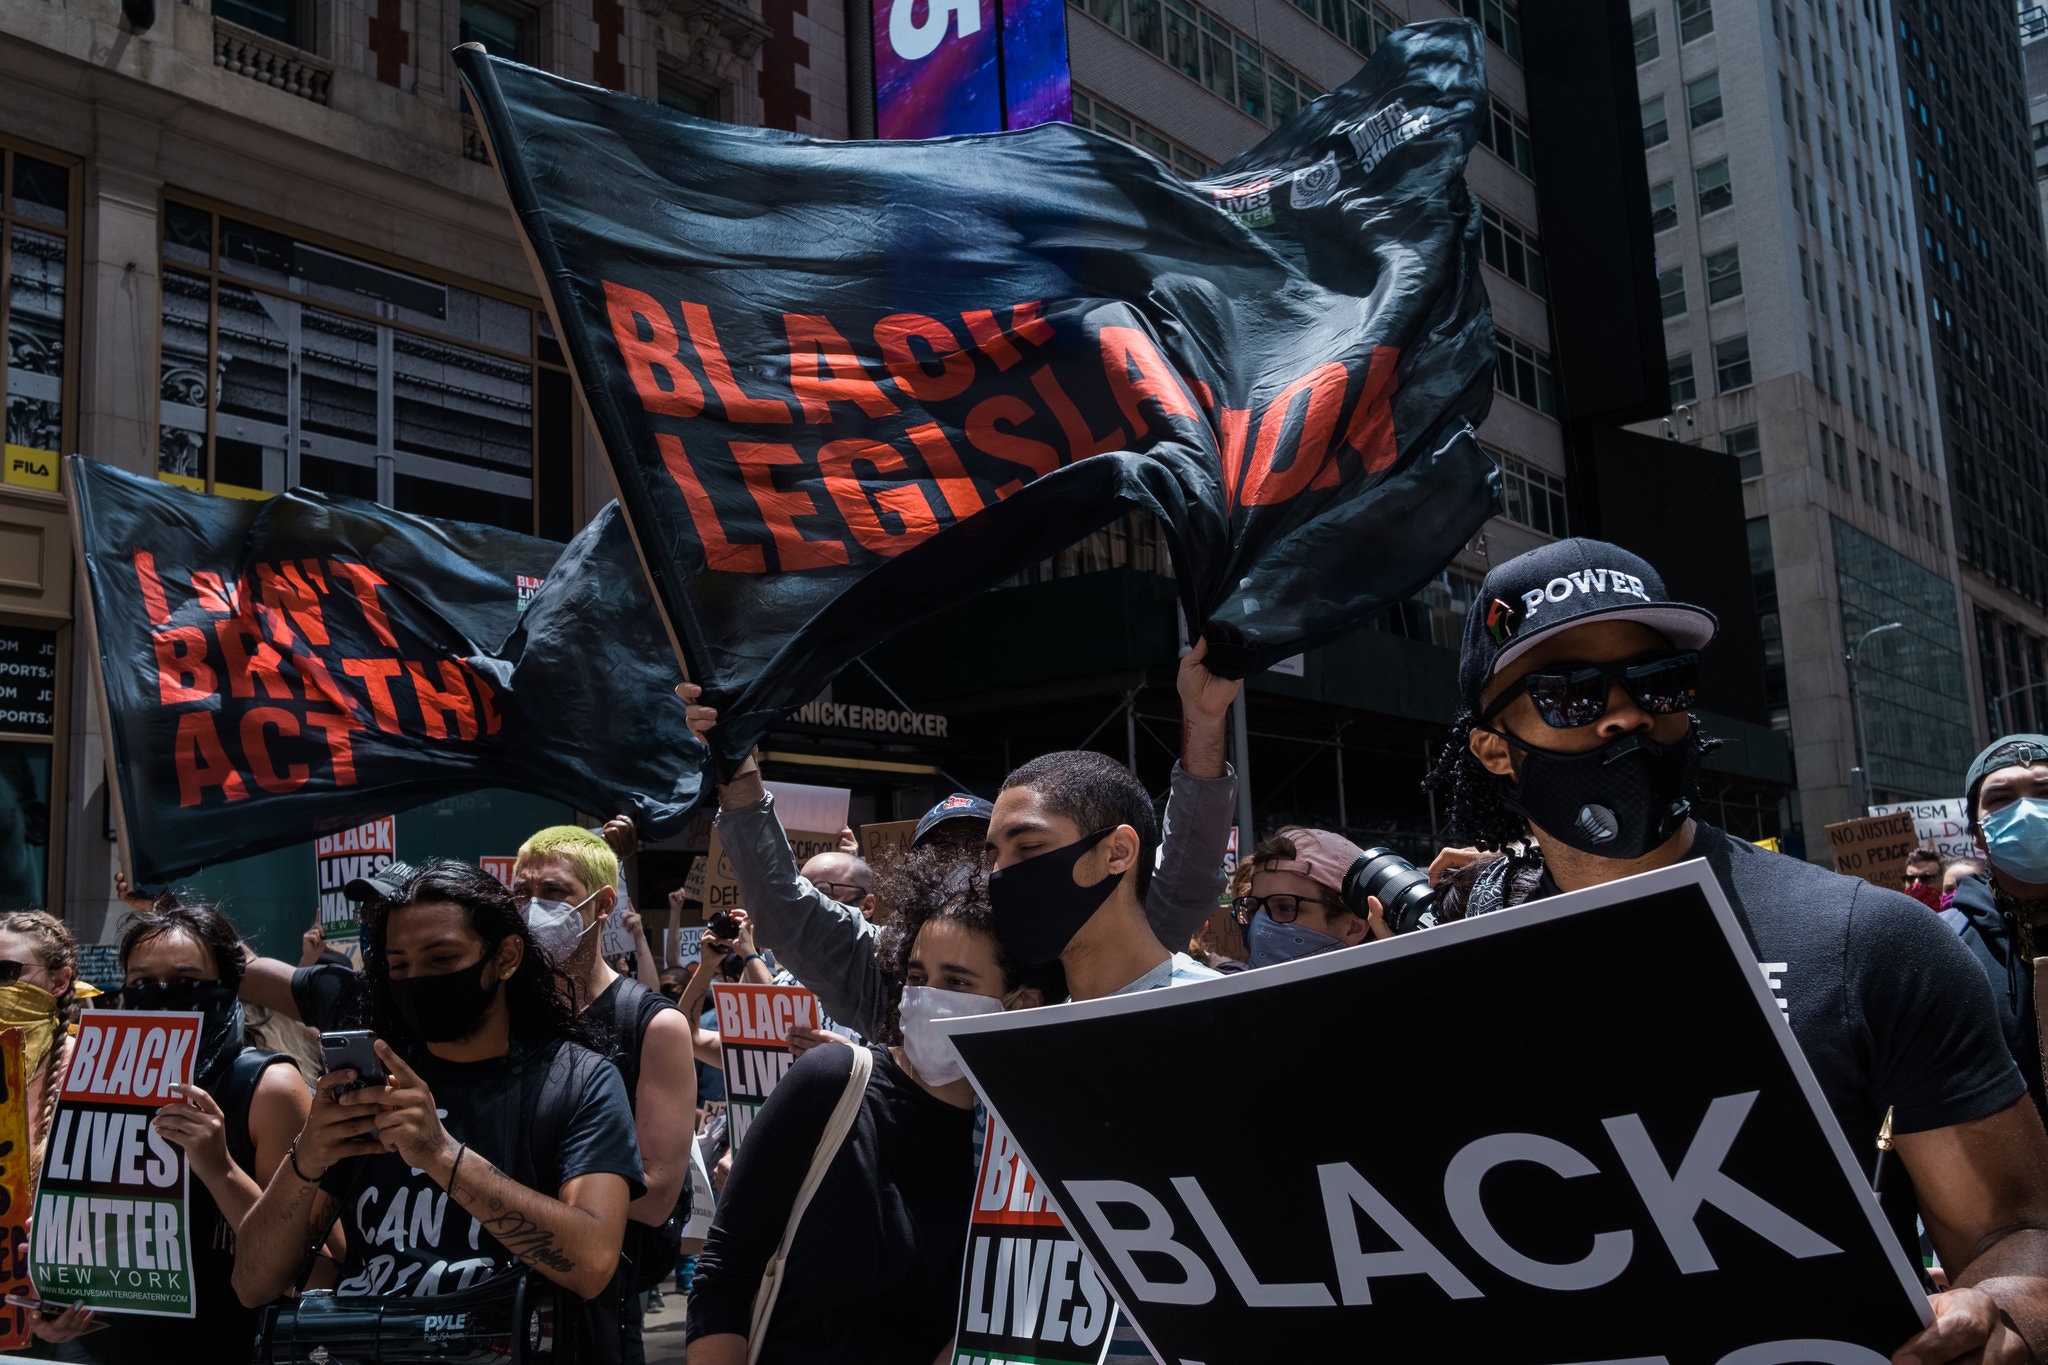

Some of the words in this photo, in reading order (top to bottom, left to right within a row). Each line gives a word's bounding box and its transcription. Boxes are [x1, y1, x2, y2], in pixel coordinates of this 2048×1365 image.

[601, 279, 1056, 428] BLACK
[13, 459, 49, 477] FILA
[1521, 568, 1651, 619] POWER
[174, 707, 366, 808] ACT
[319, 820, 392, 855] BLACK
[1830, 826, 1855, 846] NO
[1857, 815, 1913, 842] JUSTICE
[1838, 854, 1863, 872] NO
[1866, 843, 1911, 865] PEACE
[718, 992, 812, 1041] BLACK
[66, 1025, 195, 1099] BLACK
[48, 1109, 179, 1188] LIVES
[1061, 1089, 1846, 1308] BLACK
[35, 1194, 183, 1271] MATTER
[39, 1266, 91, 1285] NEW
[109, 1269, 182, 1290] YORK
[966, 1236, 1108, 1347] LIVES
[424, 1313, 466, 1332] PYLE
